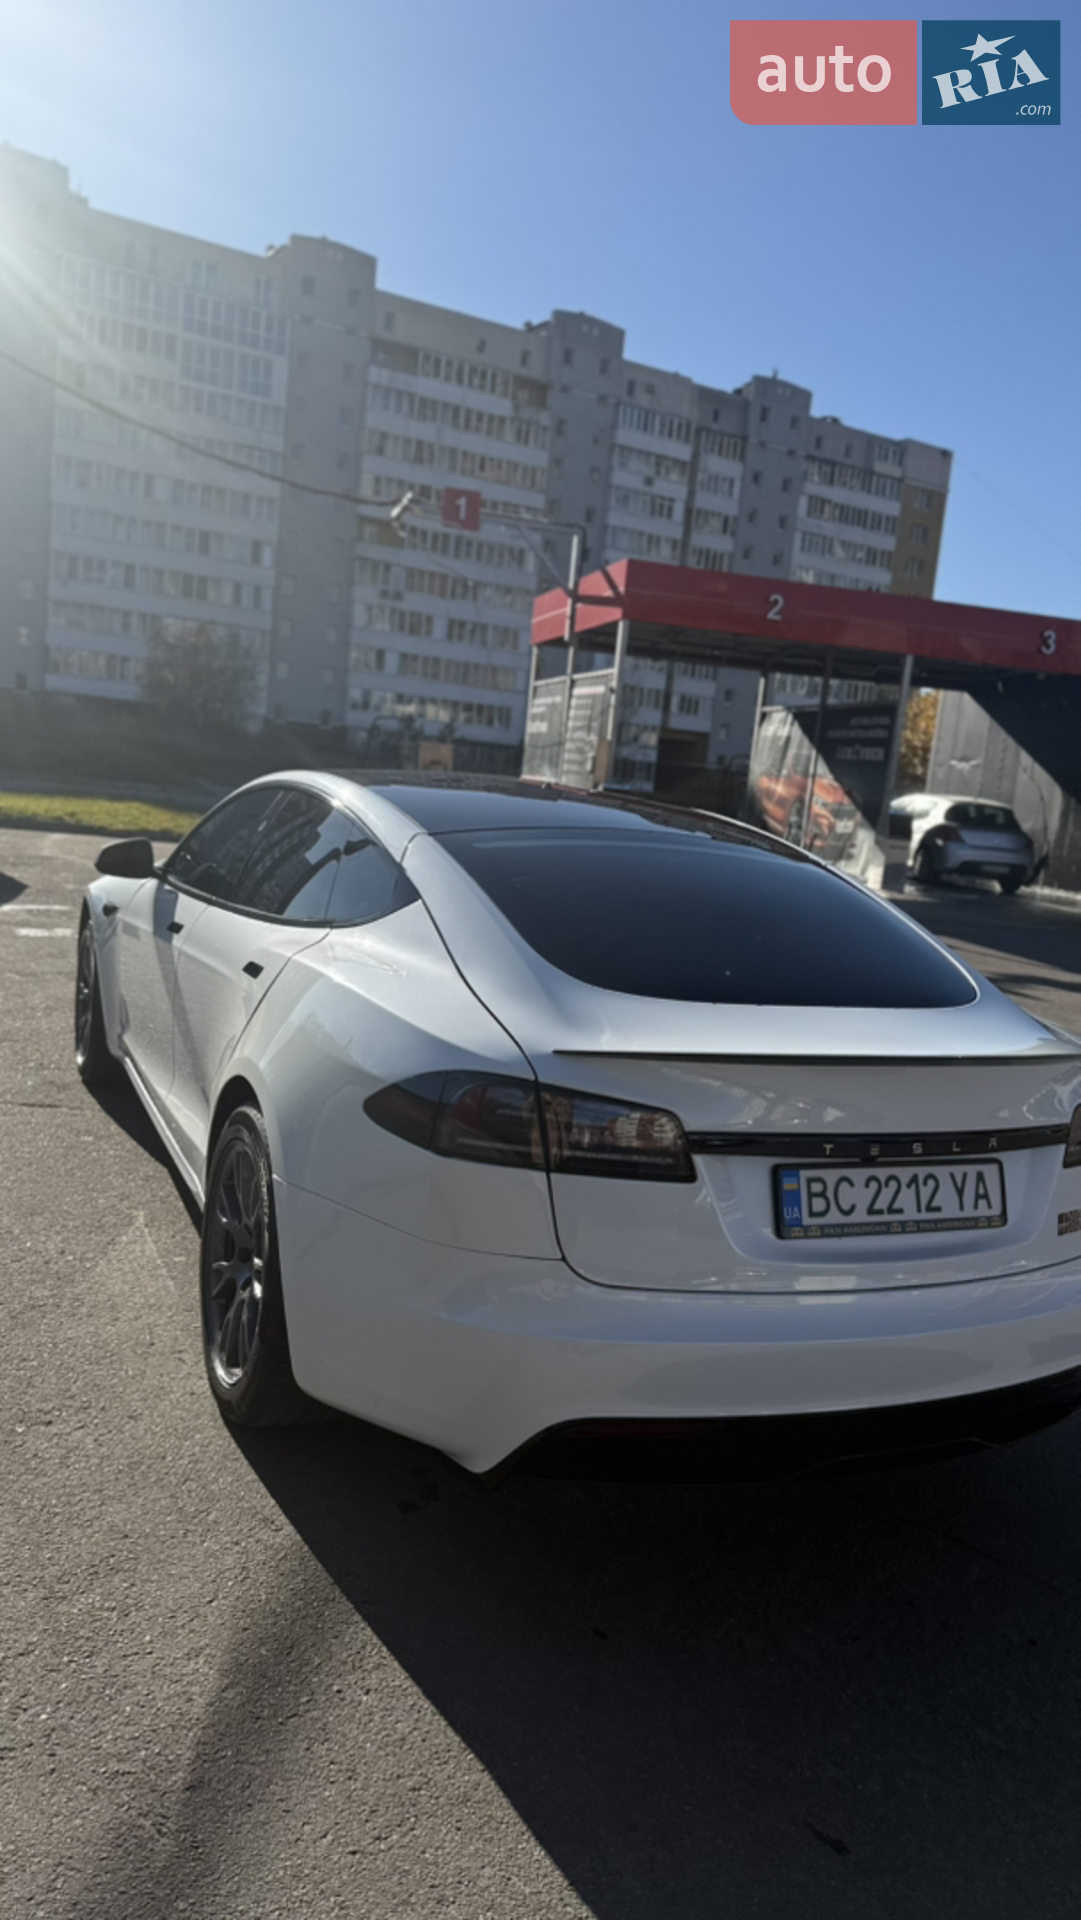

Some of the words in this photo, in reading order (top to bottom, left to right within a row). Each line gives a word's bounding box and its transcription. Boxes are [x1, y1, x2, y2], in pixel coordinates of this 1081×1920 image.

[455, 496, 467, 520] 1
[766, 594, 784, 621] 2
[1041, 629, 1057, 655] 3
[823, 1137, 998, 1156] TESLA
[806, 1175, 857, 1218] BC
[864, 1172, 943, 1217] 2212
[948, 1170, 993, 1212] YA
[783, 1205, 801, 1219] UA
[824, 1227, 840, 1235] PAN
